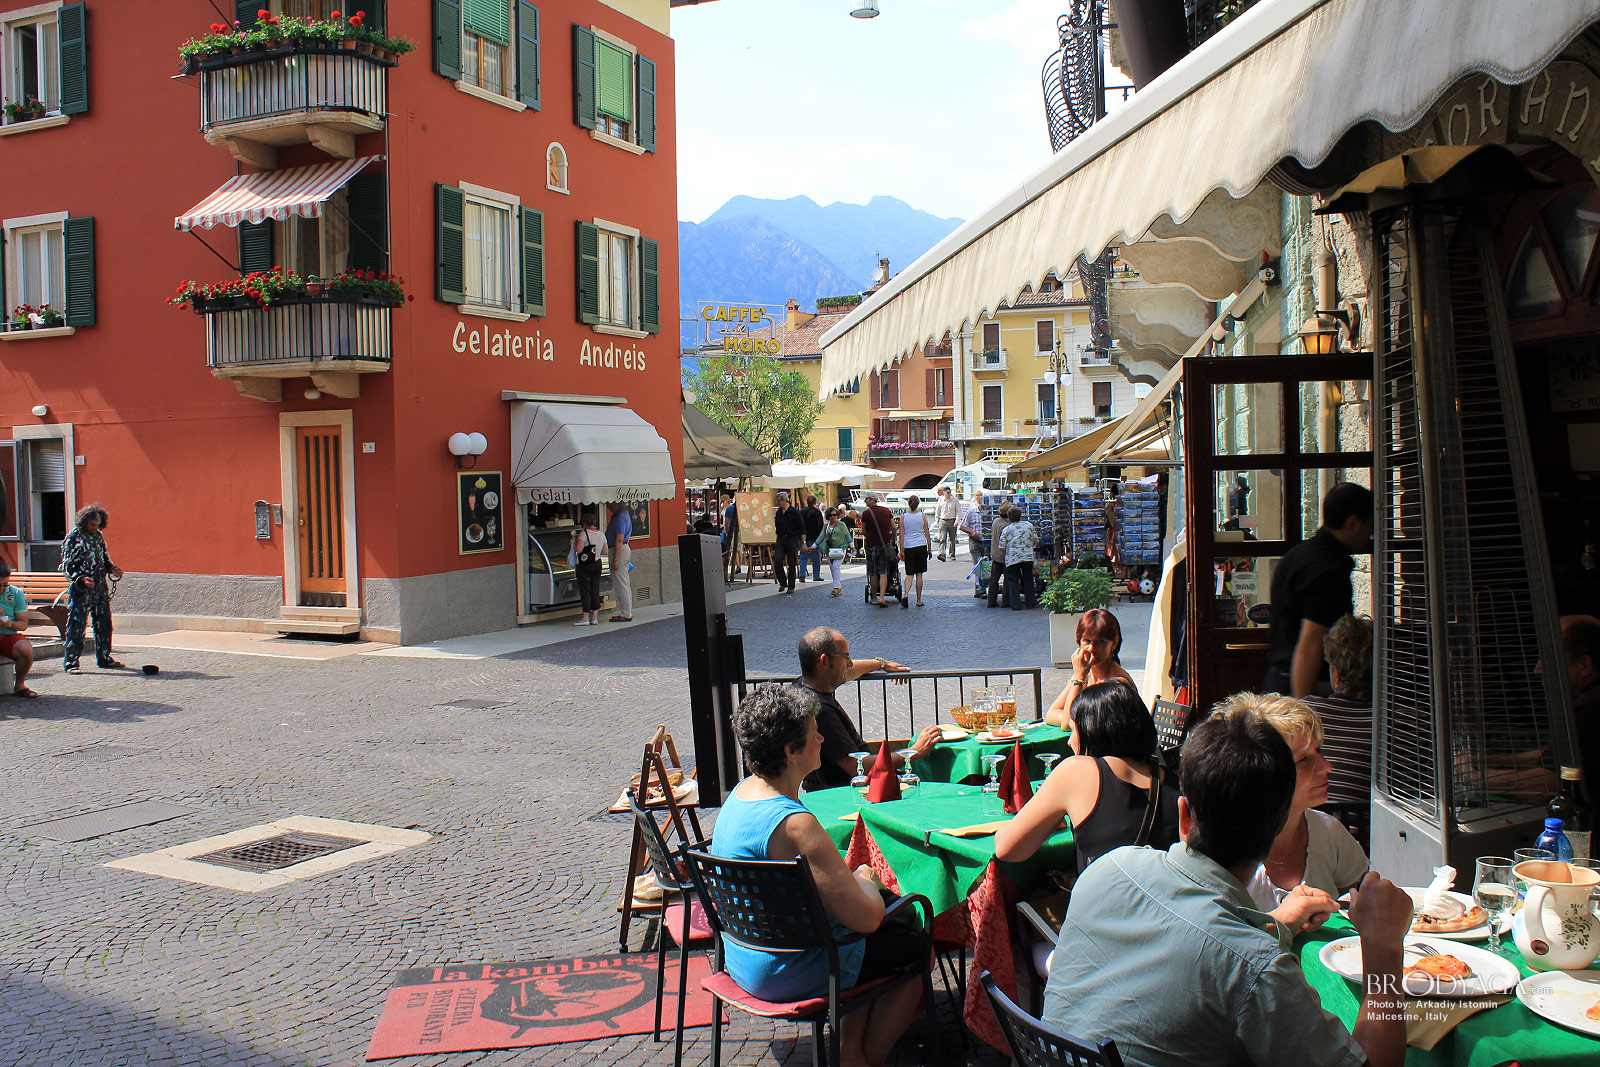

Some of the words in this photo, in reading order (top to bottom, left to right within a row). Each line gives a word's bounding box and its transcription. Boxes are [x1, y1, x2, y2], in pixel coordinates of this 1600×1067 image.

[452, 321, 554, 361] Gelateria
[579, 338, 646, 371] Andreis
[724, 336, 781, 353] MORO
[530, 488, 572, 501] Gelati
[616, 487, 651, 500] Gelateria
[430, 967, 469, 983] la
[480, 953, 671, 981] kambusa
[406, 992, 428, 1009] PUB
[419, 989, 453, 1045] RISTORANTE
